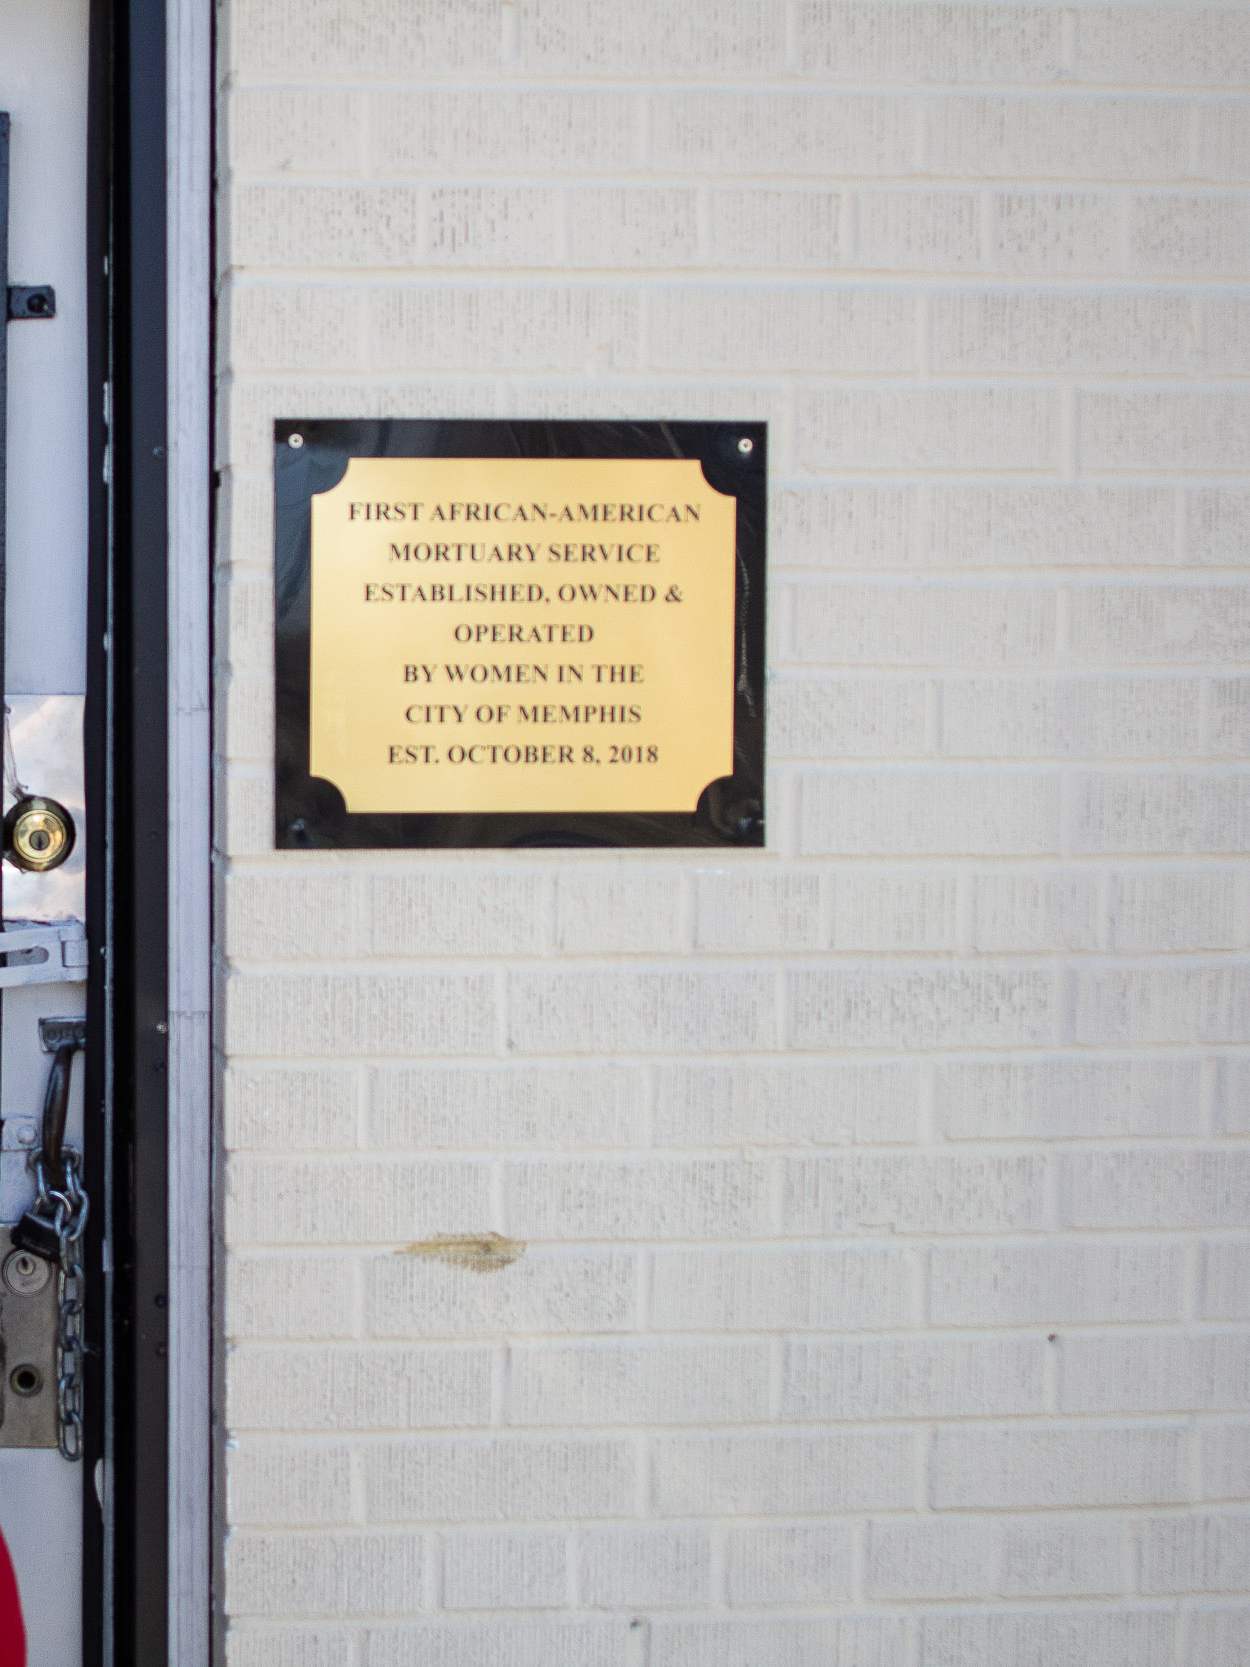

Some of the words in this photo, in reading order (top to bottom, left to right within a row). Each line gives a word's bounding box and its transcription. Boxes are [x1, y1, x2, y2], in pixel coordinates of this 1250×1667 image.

[348, 502, 424, 523] FIRST
[430, 502, 702, 523] AFRICAN-AMERICAN
[389, 542, 542, 563] MORTUARY
[549, 542, 661, 563] SERVICE
[365, 583, 551, 606] ESTABLISHED,
[558, 583, 656, 604] OWNED
[664, 583, 684, 604] &
[454, 624, 595, 644] OPERATED
[403, 664, 437, 683] BY
[447, 664, 549, 684] WOMEN
[557, 664, 583, 683] IN
[591, 664, 645, 683] THE
[405, 704, 468, 725] CITY
[476, 704, 509, 725] OF
[518, 704, 643, 725] MEMPHIS
[388, 745, 440, 765] EST.
[448, 745, 575, 765] OCTOBER
[583, 745, 601, 768] 8,
[608, 745, 659, 765] 2018
